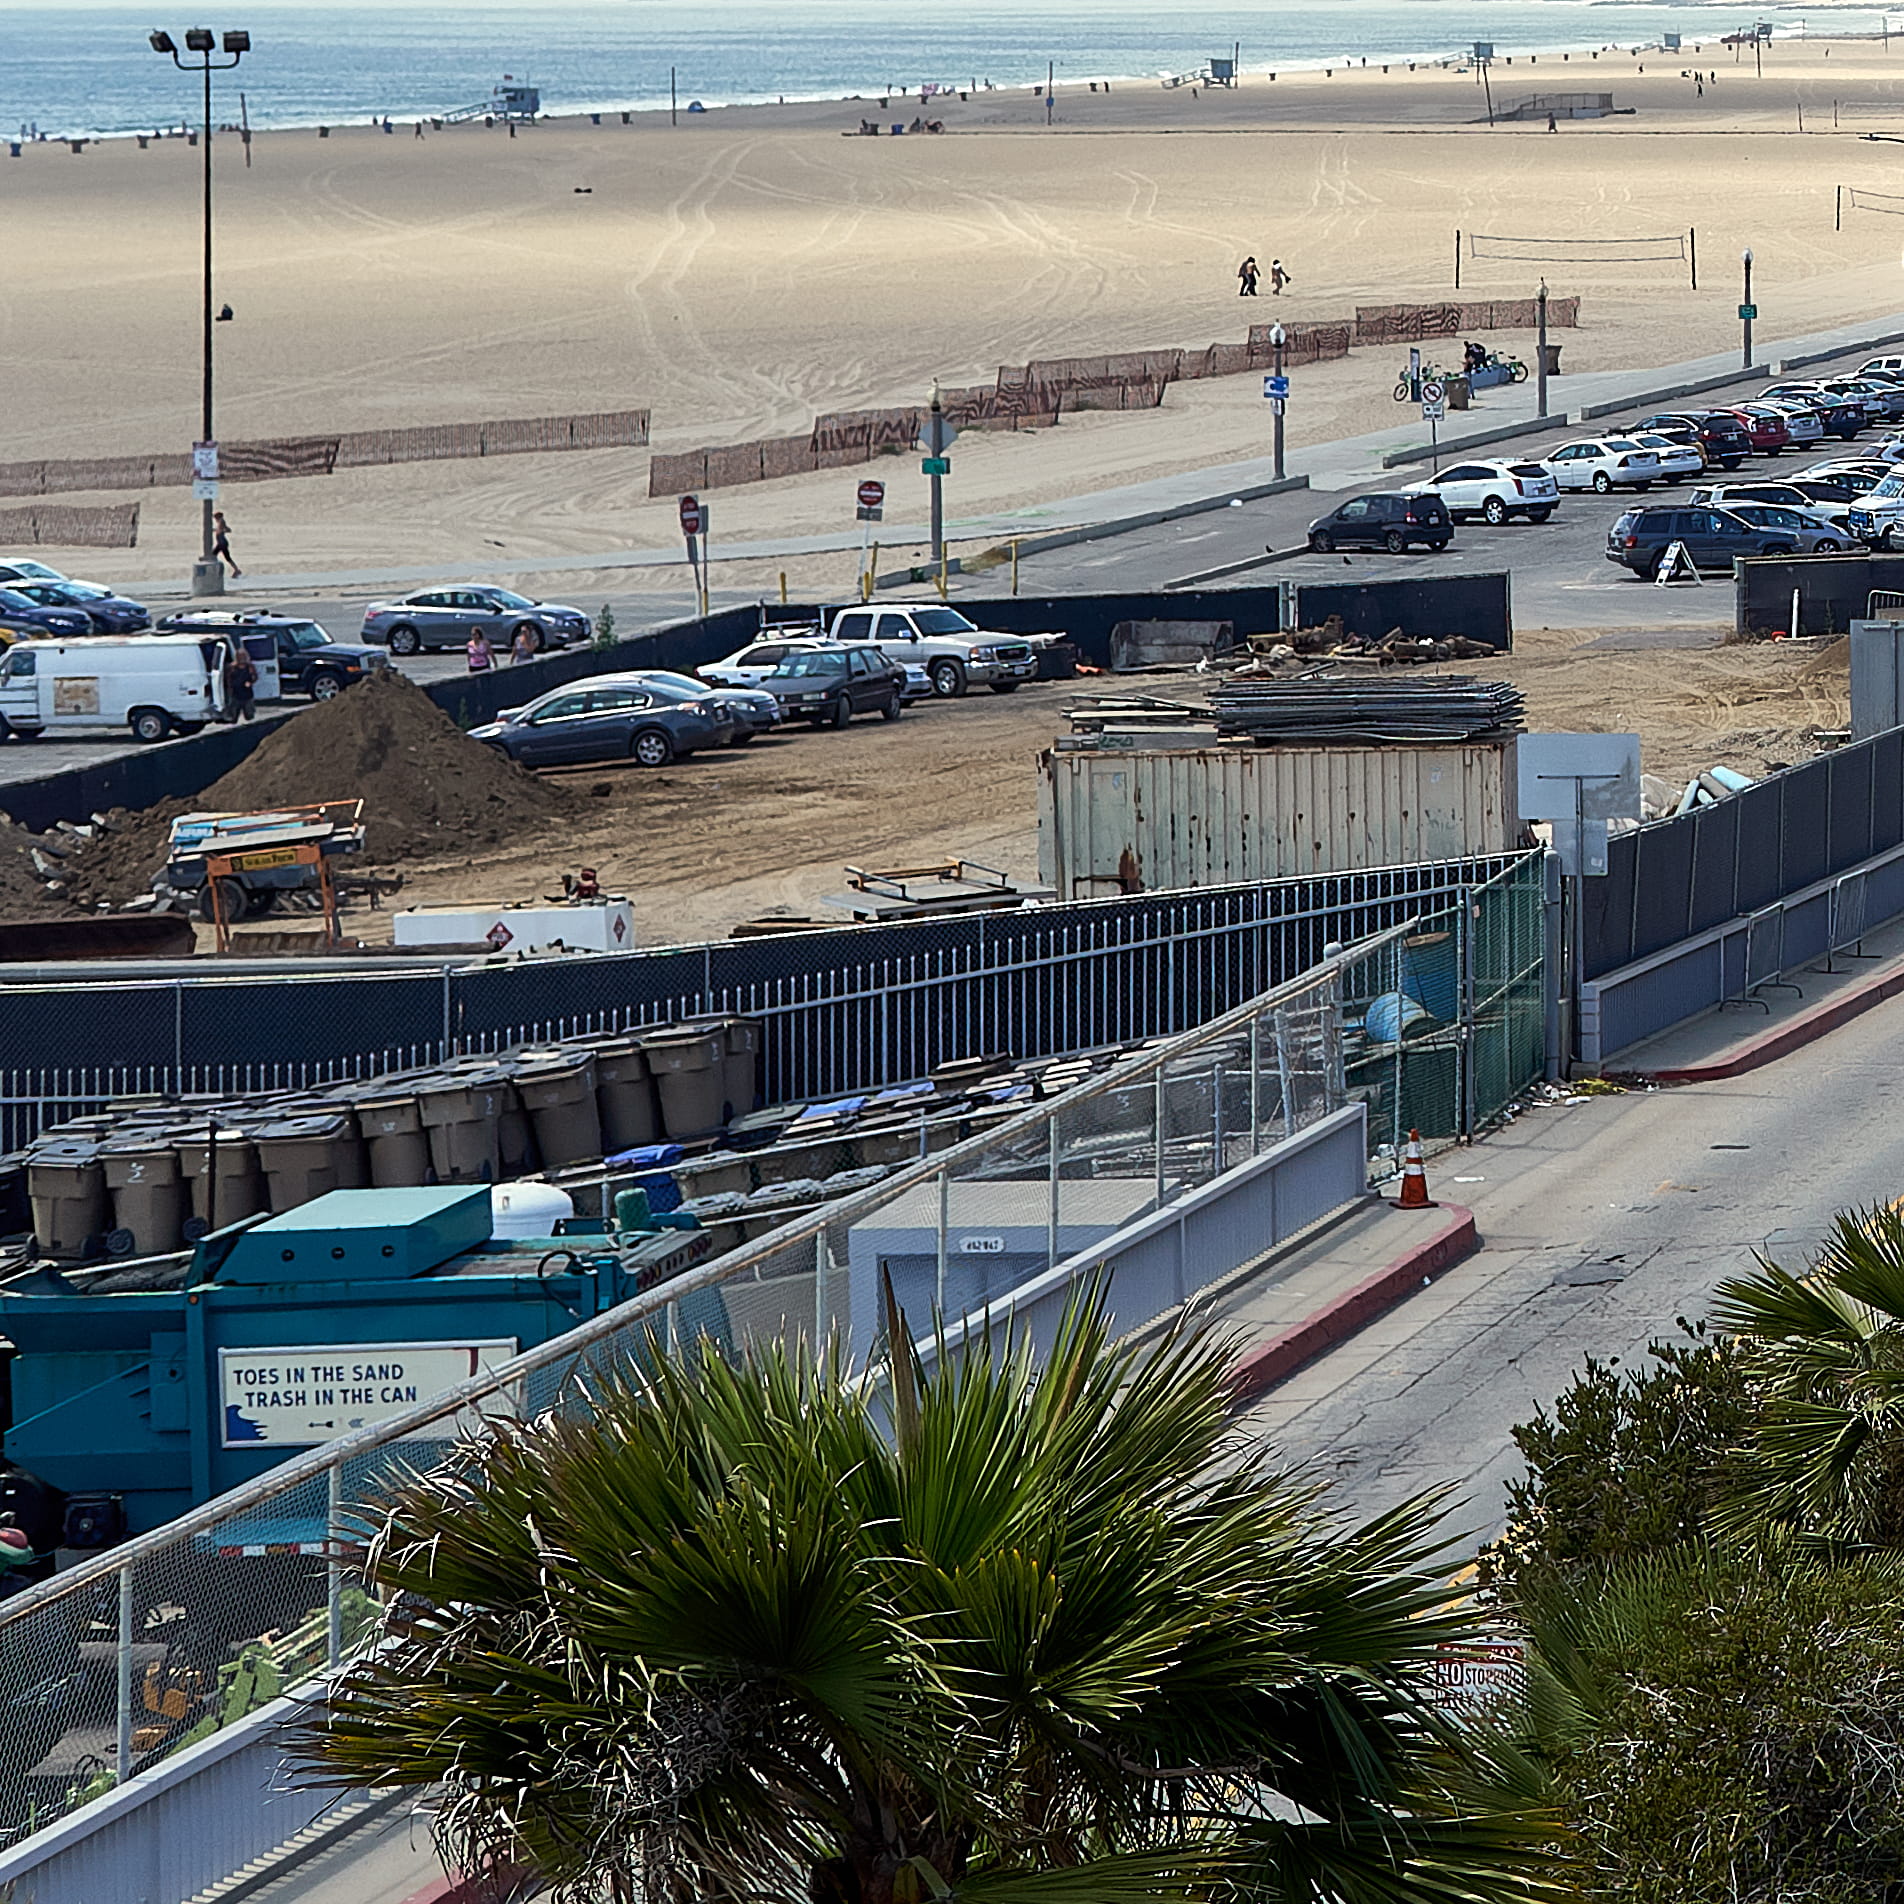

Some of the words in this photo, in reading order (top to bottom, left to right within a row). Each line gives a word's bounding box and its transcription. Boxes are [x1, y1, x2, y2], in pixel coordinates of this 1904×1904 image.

[232, 1367, 279, 1386] TOES
[286, 1366, 305, 1383] IN
[310, 1365, 345, 1383] THE
[352, 1363, 404, 1381] SAND
[244, 1389, 306, 1408] TRASH
[315, 1388, 334, 1405] IN
[339, 1387, 374, 1404] THE
[379, 1385, 417, 1403] CAN
